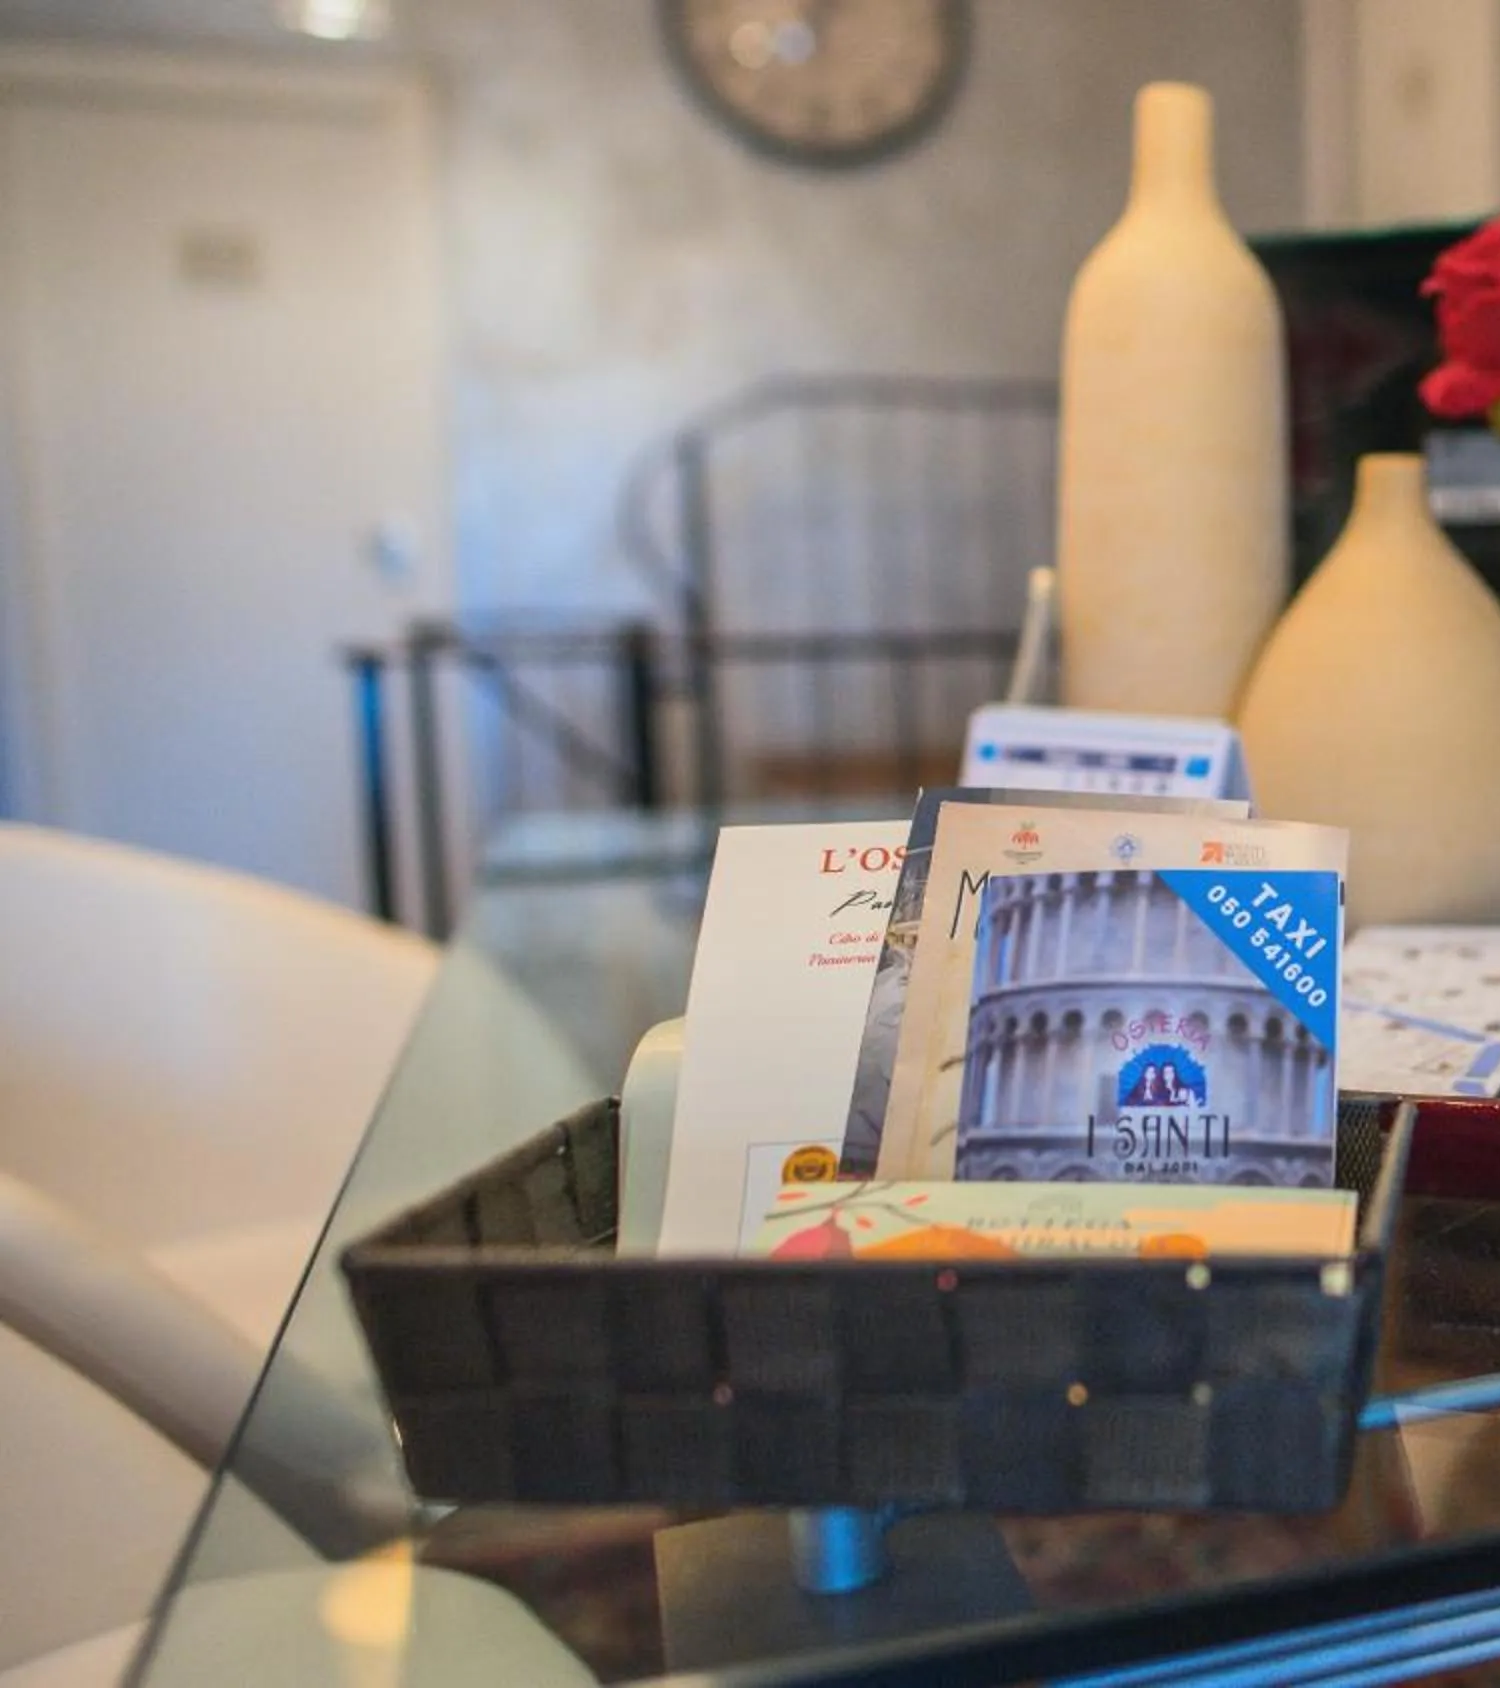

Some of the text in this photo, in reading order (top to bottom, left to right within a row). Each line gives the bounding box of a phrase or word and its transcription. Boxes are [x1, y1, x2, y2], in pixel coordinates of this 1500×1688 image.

[1207, 885, 1328, 1007] 050 541600
[1252, 882, 1327, 959] TAXI
[1111, 1012, 1212, 1052] OSTERIA
[1113, 1114, 1230, 1160] SANTI
